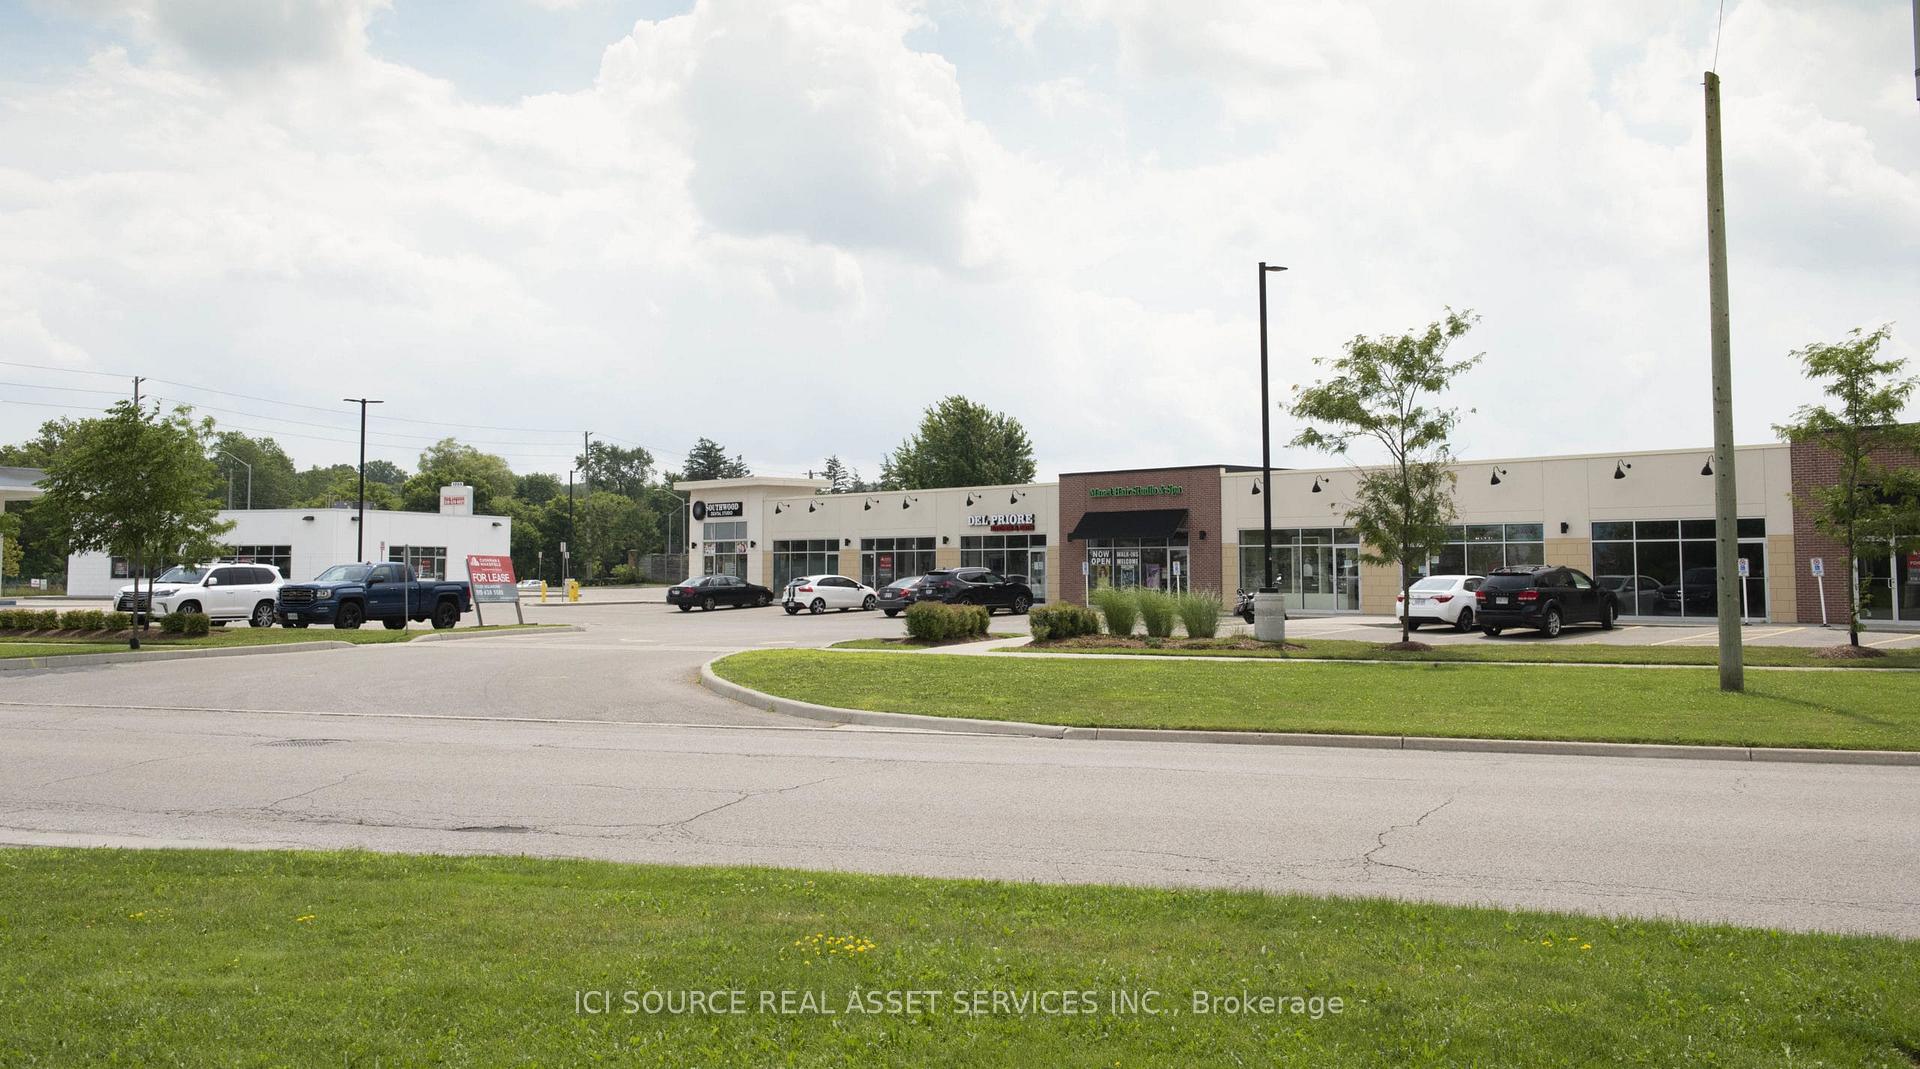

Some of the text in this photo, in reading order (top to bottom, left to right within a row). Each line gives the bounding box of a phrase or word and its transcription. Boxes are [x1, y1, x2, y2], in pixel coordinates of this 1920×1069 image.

[705, 502, 739, 512] SOUTHWOOD
[968, 513, 1034, 526] DEL PRIORE
[1092, 550, 1110, 558] NOW
[472, 573, 510, 582] FOR LEASE
